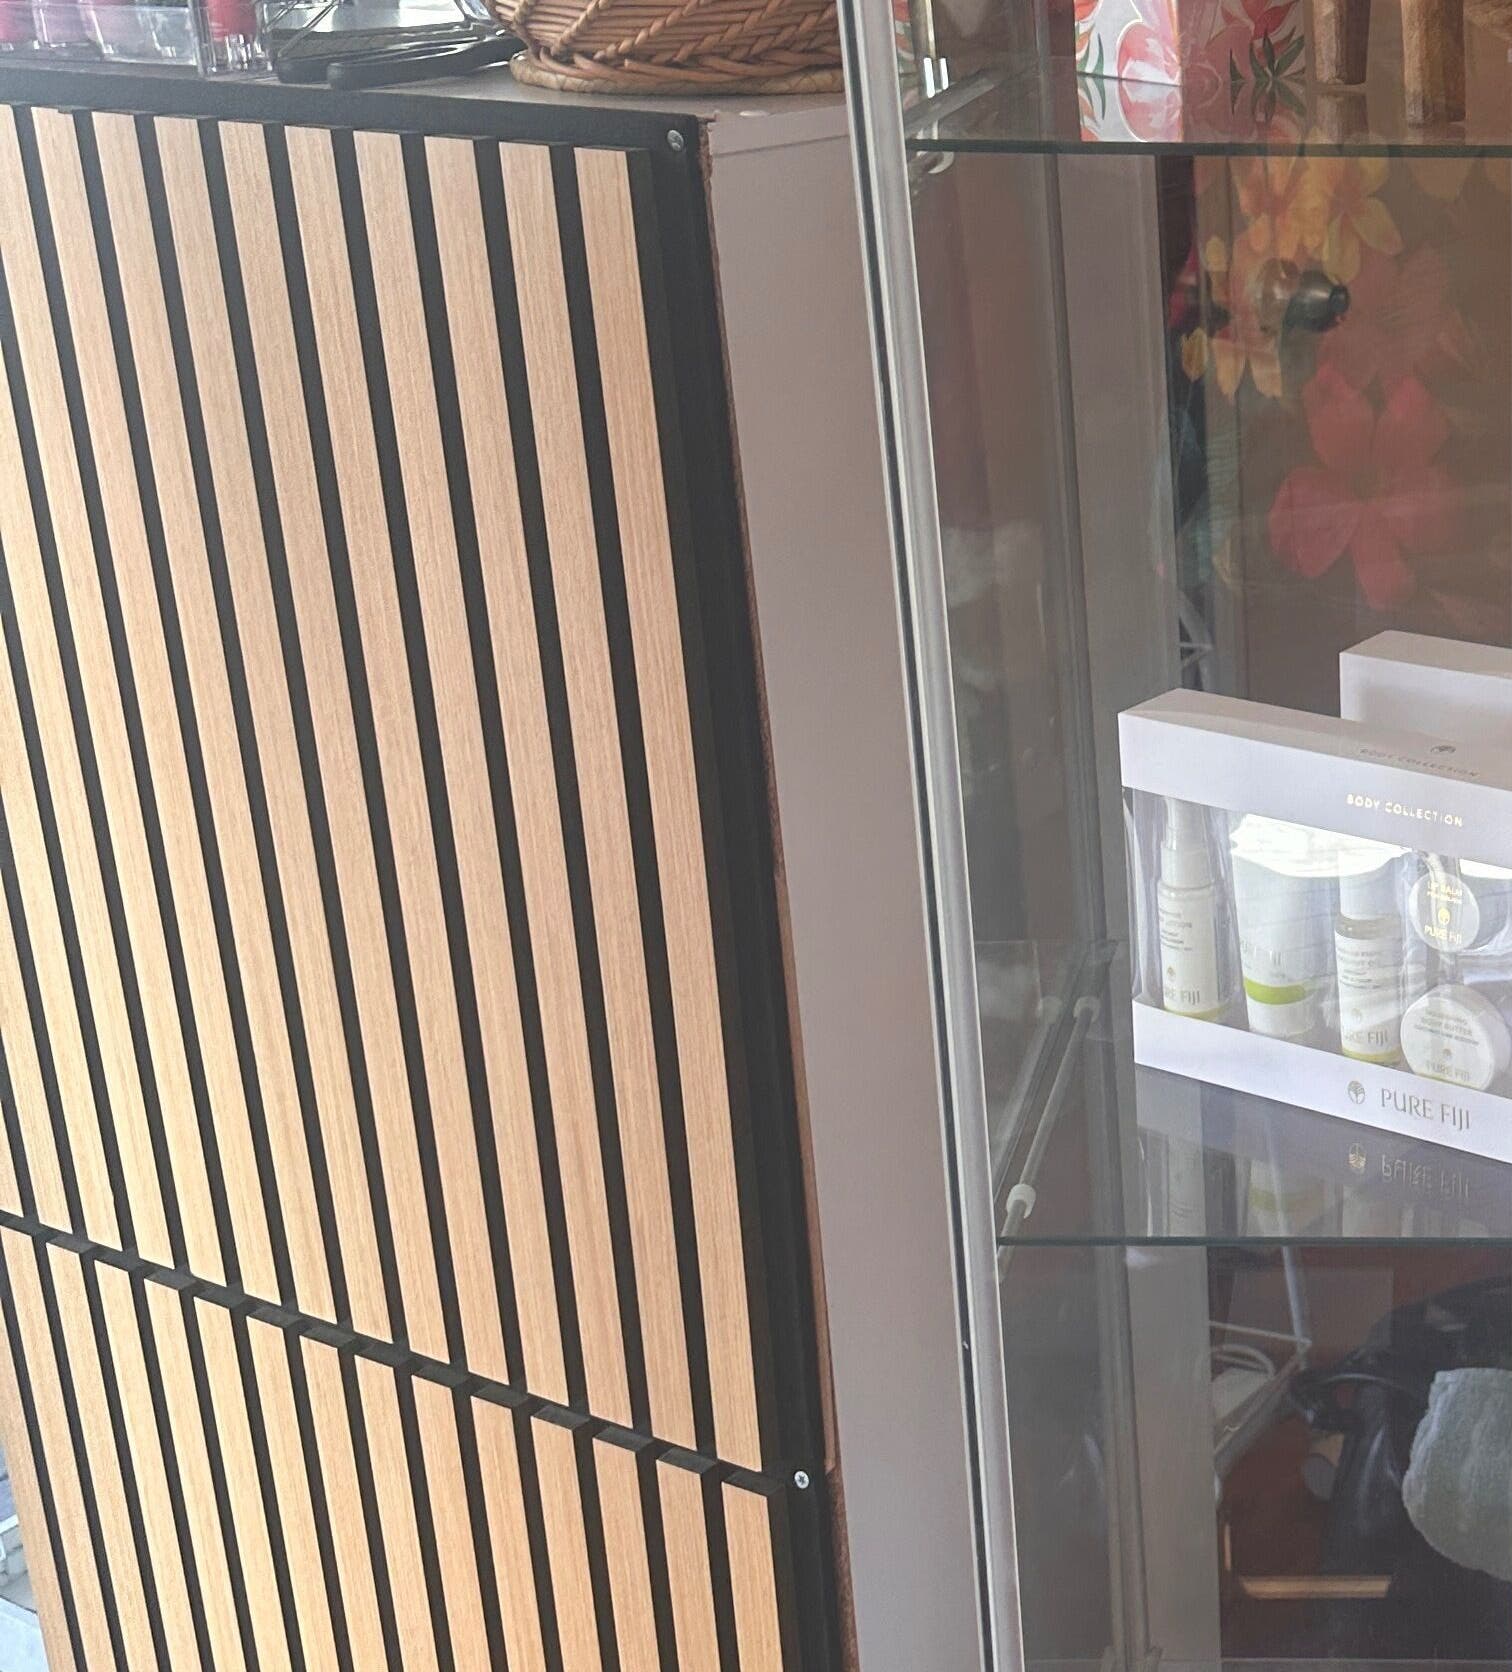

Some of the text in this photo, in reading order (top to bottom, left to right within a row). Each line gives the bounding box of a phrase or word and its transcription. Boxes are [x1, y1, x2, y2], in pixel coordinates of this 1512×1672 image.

[1346, 793, 1464, 828] BODY COLLECTION
[1180, 989, 1200, 1006] FIJI
[1367, 1030, 1389, 1047] FIJI
[1381, 1087, 1470, 1132] PURE FIJI
